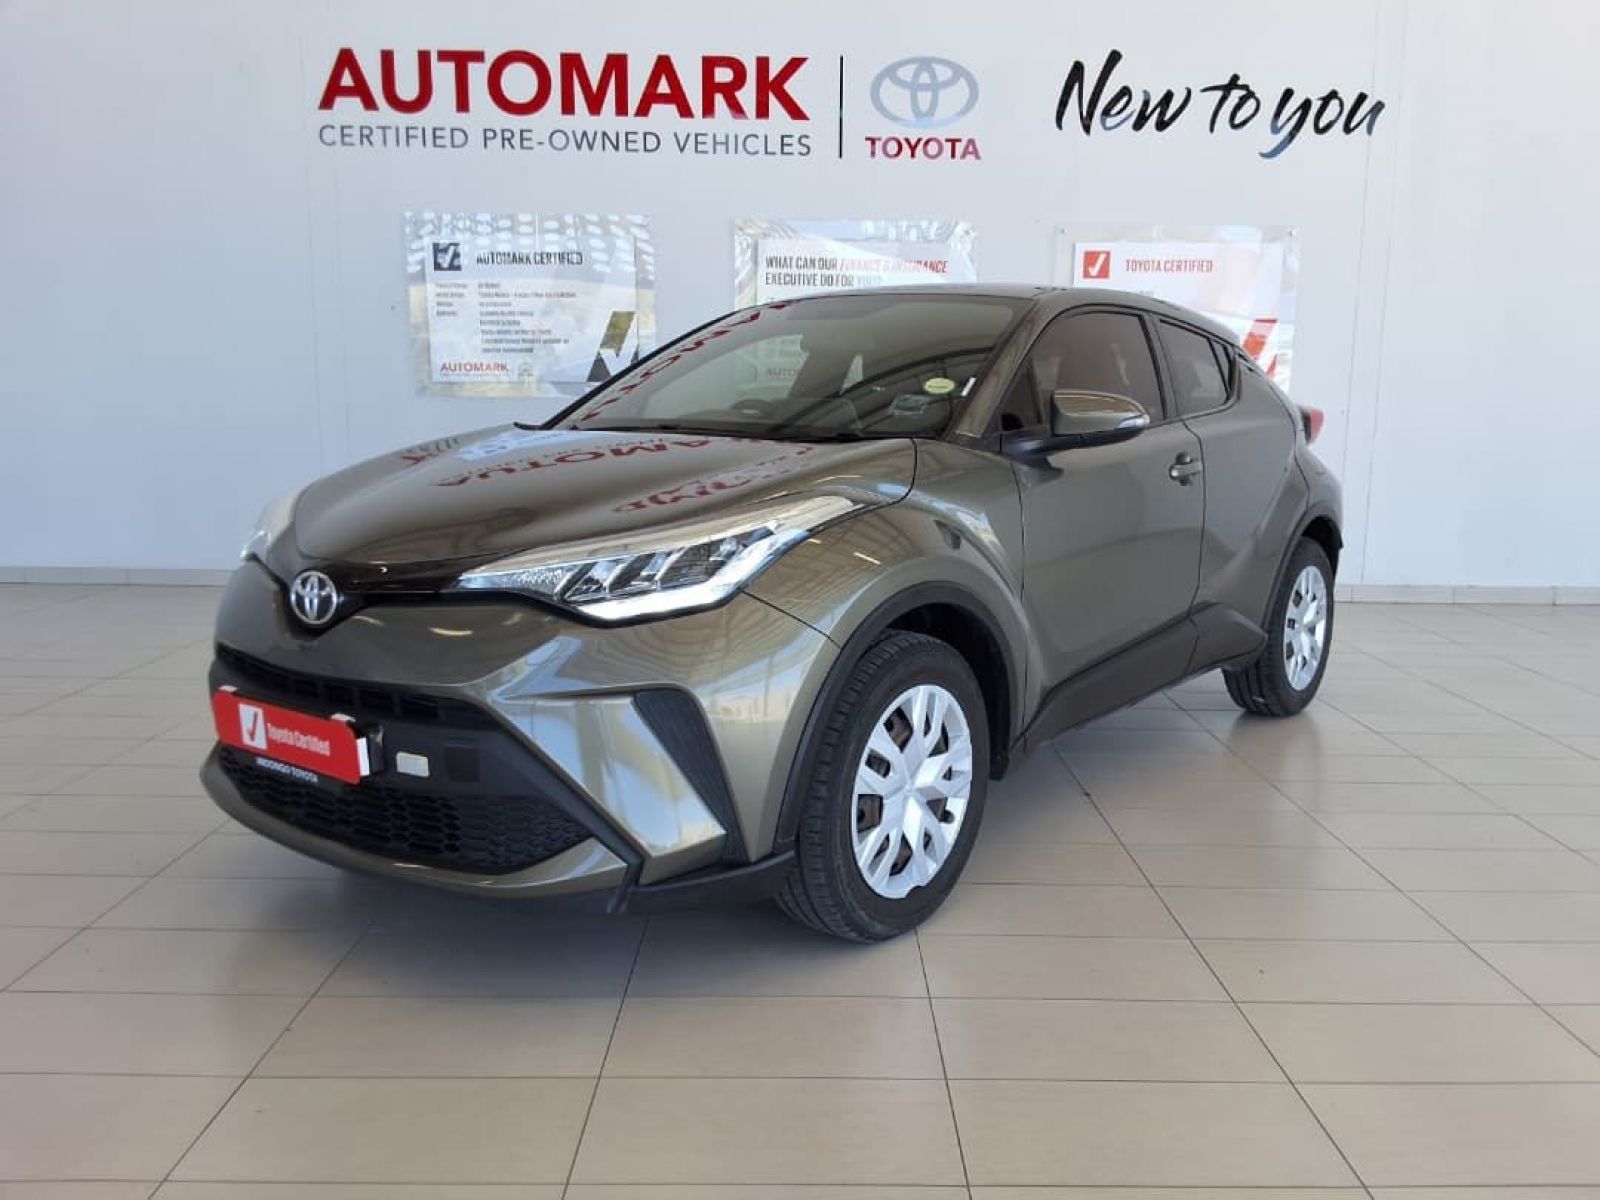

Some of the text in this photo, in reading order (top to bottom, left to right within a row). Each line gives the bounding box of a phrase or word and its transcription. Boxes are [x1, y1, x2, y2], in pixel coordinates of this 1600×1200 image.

[318, 47, 811, 121] AUTOMARK
[1055, 49, 1386, 158] New to you
[318, 124, 811, 156] CERTIFIED PRE-OWNED VEHICLES
[865, 136, 981, 160] TOYOTA
[476, 251, 583, 265] AUTOMARK CERTIFIED
[766, 255, 793, 270] WHAT
[795, 256, 816, 270] CAN
[818, 257, 837, 271] OUR
[1126, 259, 1213, 273] TOYOTA CERTIFIED
[765, 272, 818, 286] EXECUTIVE
[820, 273, 834, 287] DO
[835, 273, 854, 288] FOR
[441, 362, 509, 373] AUTOMARK
[267, 723, 295, 745] Toyota
